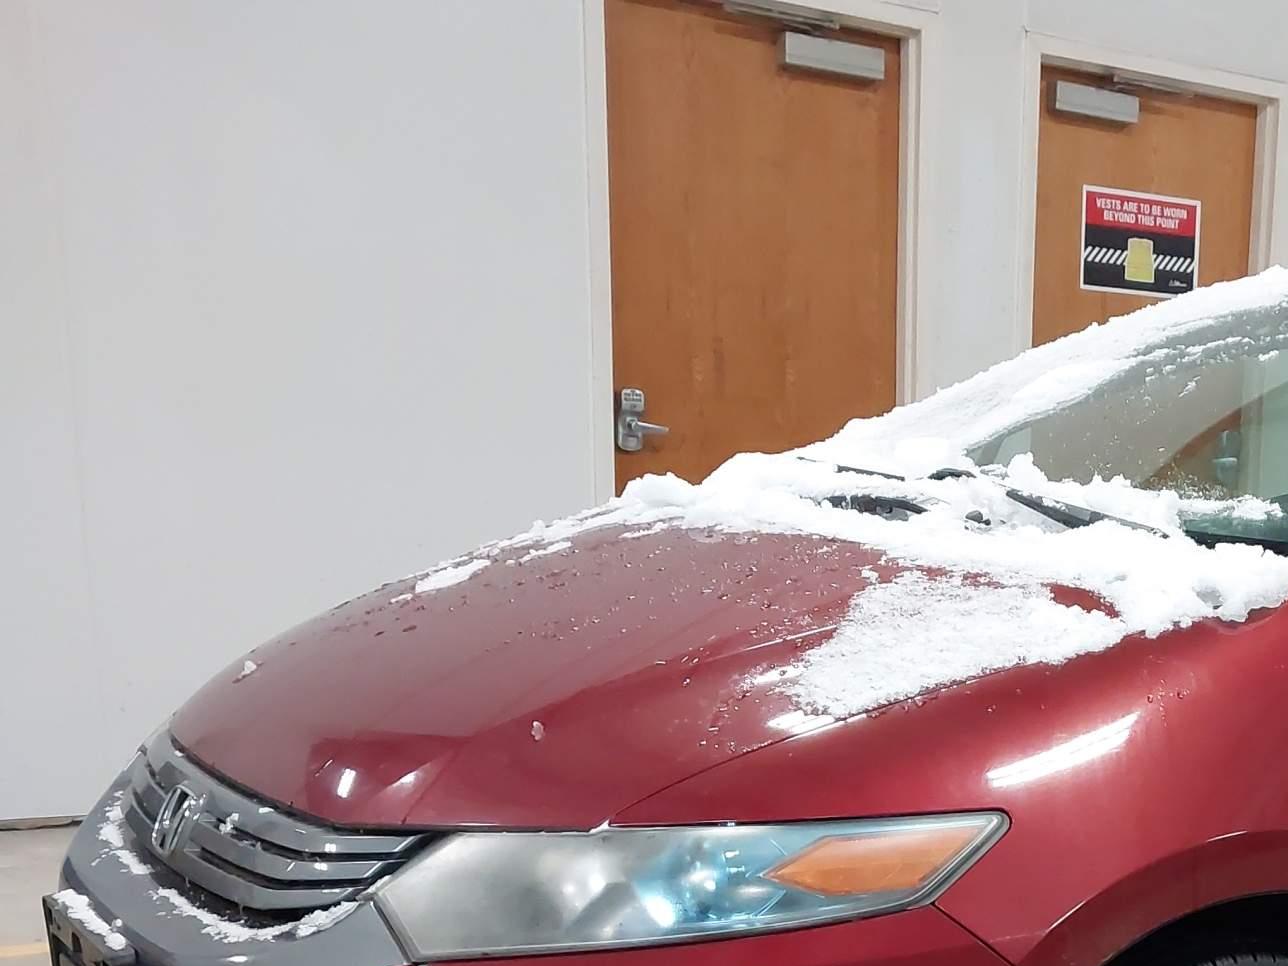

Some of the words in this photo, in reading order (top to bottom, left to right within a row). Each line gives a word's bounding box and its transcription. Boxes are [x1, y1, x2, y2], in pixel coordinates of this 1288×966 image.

[1095, 197, 1122, 210] VESTS
[1123, 201, 1138, 212] ARE
[1140, 203, 1150, 214] TO
[1151, 205, 1161, 215] BE
[1163, 206, 1188, 219] WORN
[1103, 210, 1136, 224] BEYOND
[1137, 214, 1154, 226] THIS
[1156, 217, 1180, 229] POINT
